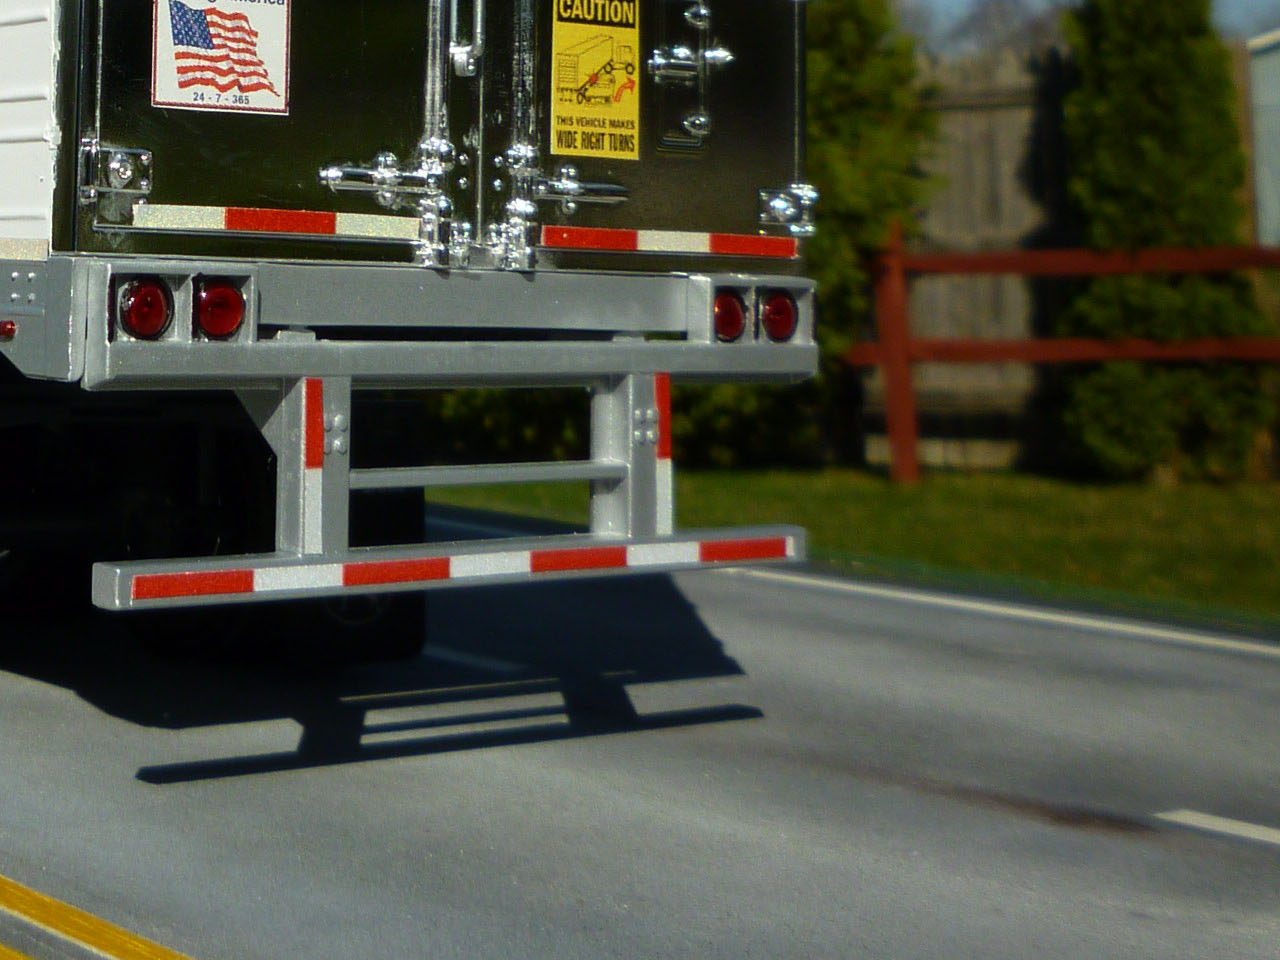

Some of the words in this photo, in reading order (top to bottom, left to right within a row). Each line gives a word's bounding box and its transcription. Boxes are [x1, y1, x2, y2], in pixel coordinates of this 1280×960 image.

[193, 92, 204, 102] 24
[216, 93, 221, 102] 7
[232, 94, 250, 105] 365
[556, 115, 574, 126] THIS
[576, 116, 607, 128] VEHICLE
[608, 119, 635, 130] MAKES
[556, 129, 578, 149] WIDE
[581, 131, 605, 150] RIGHT
[608, 133, 635, 152] TURNS
